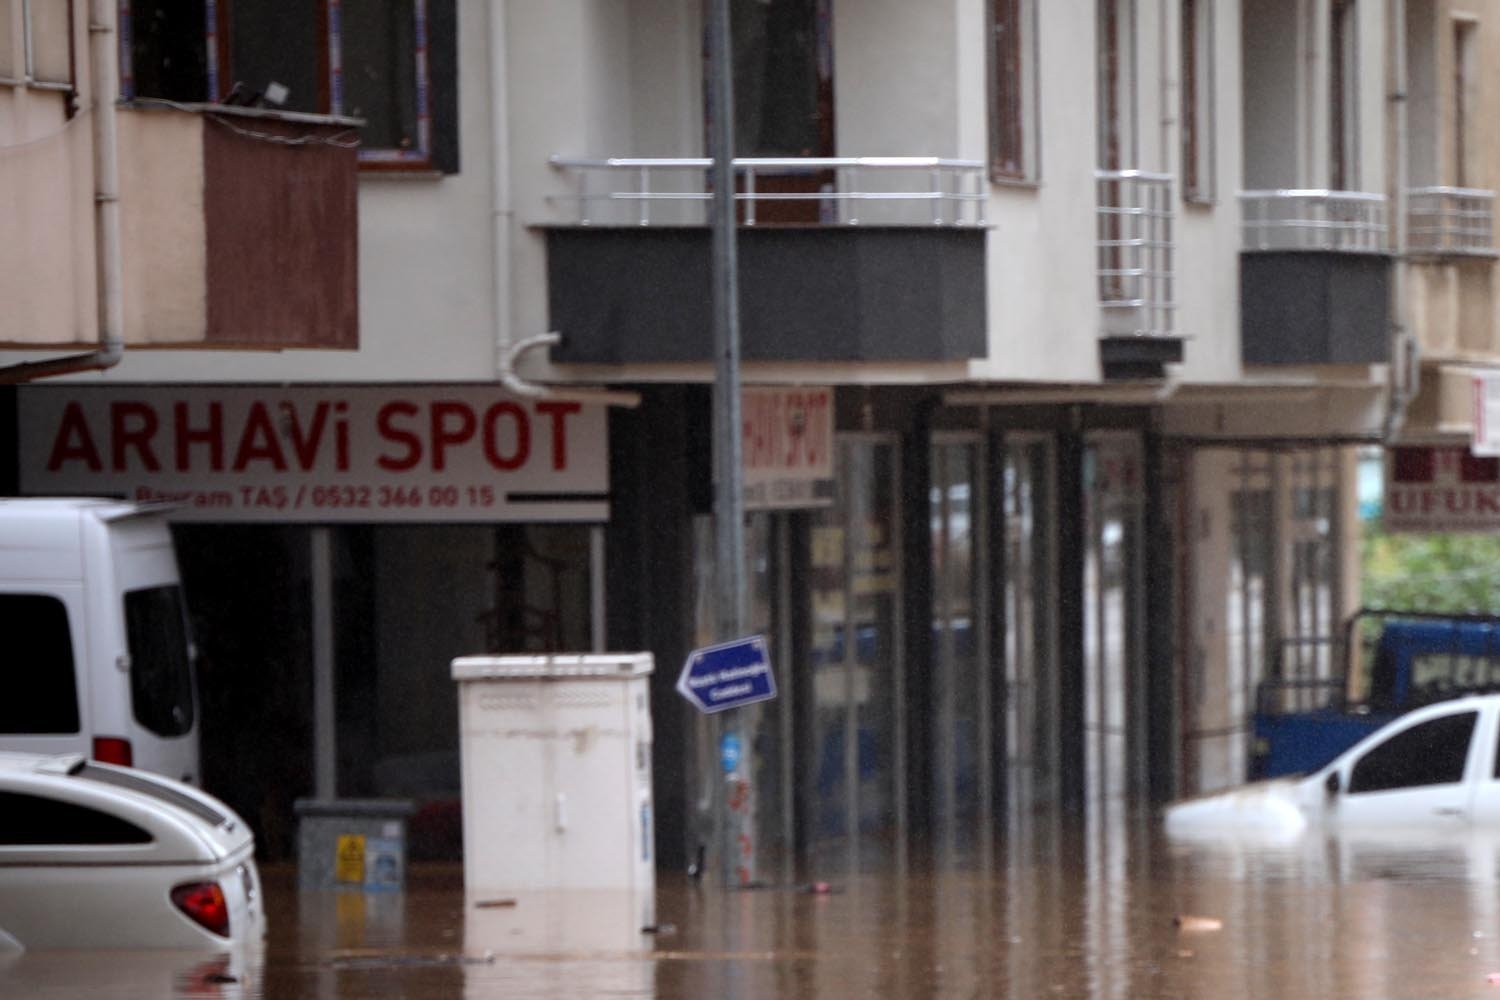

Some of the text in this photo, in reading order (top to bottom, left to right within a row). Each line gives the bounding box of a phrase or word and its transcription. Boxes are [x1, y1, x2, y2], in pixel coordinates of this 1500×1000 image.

[375, 400, 583, 473] SPOT
[239, 484, 288, 511] TAŞ
[311, 484, 371, 508] 0532
[378, 484, 423, 508] 366
[428, 484, 459, 508] 00
[466, 484, 495, 508] 15
